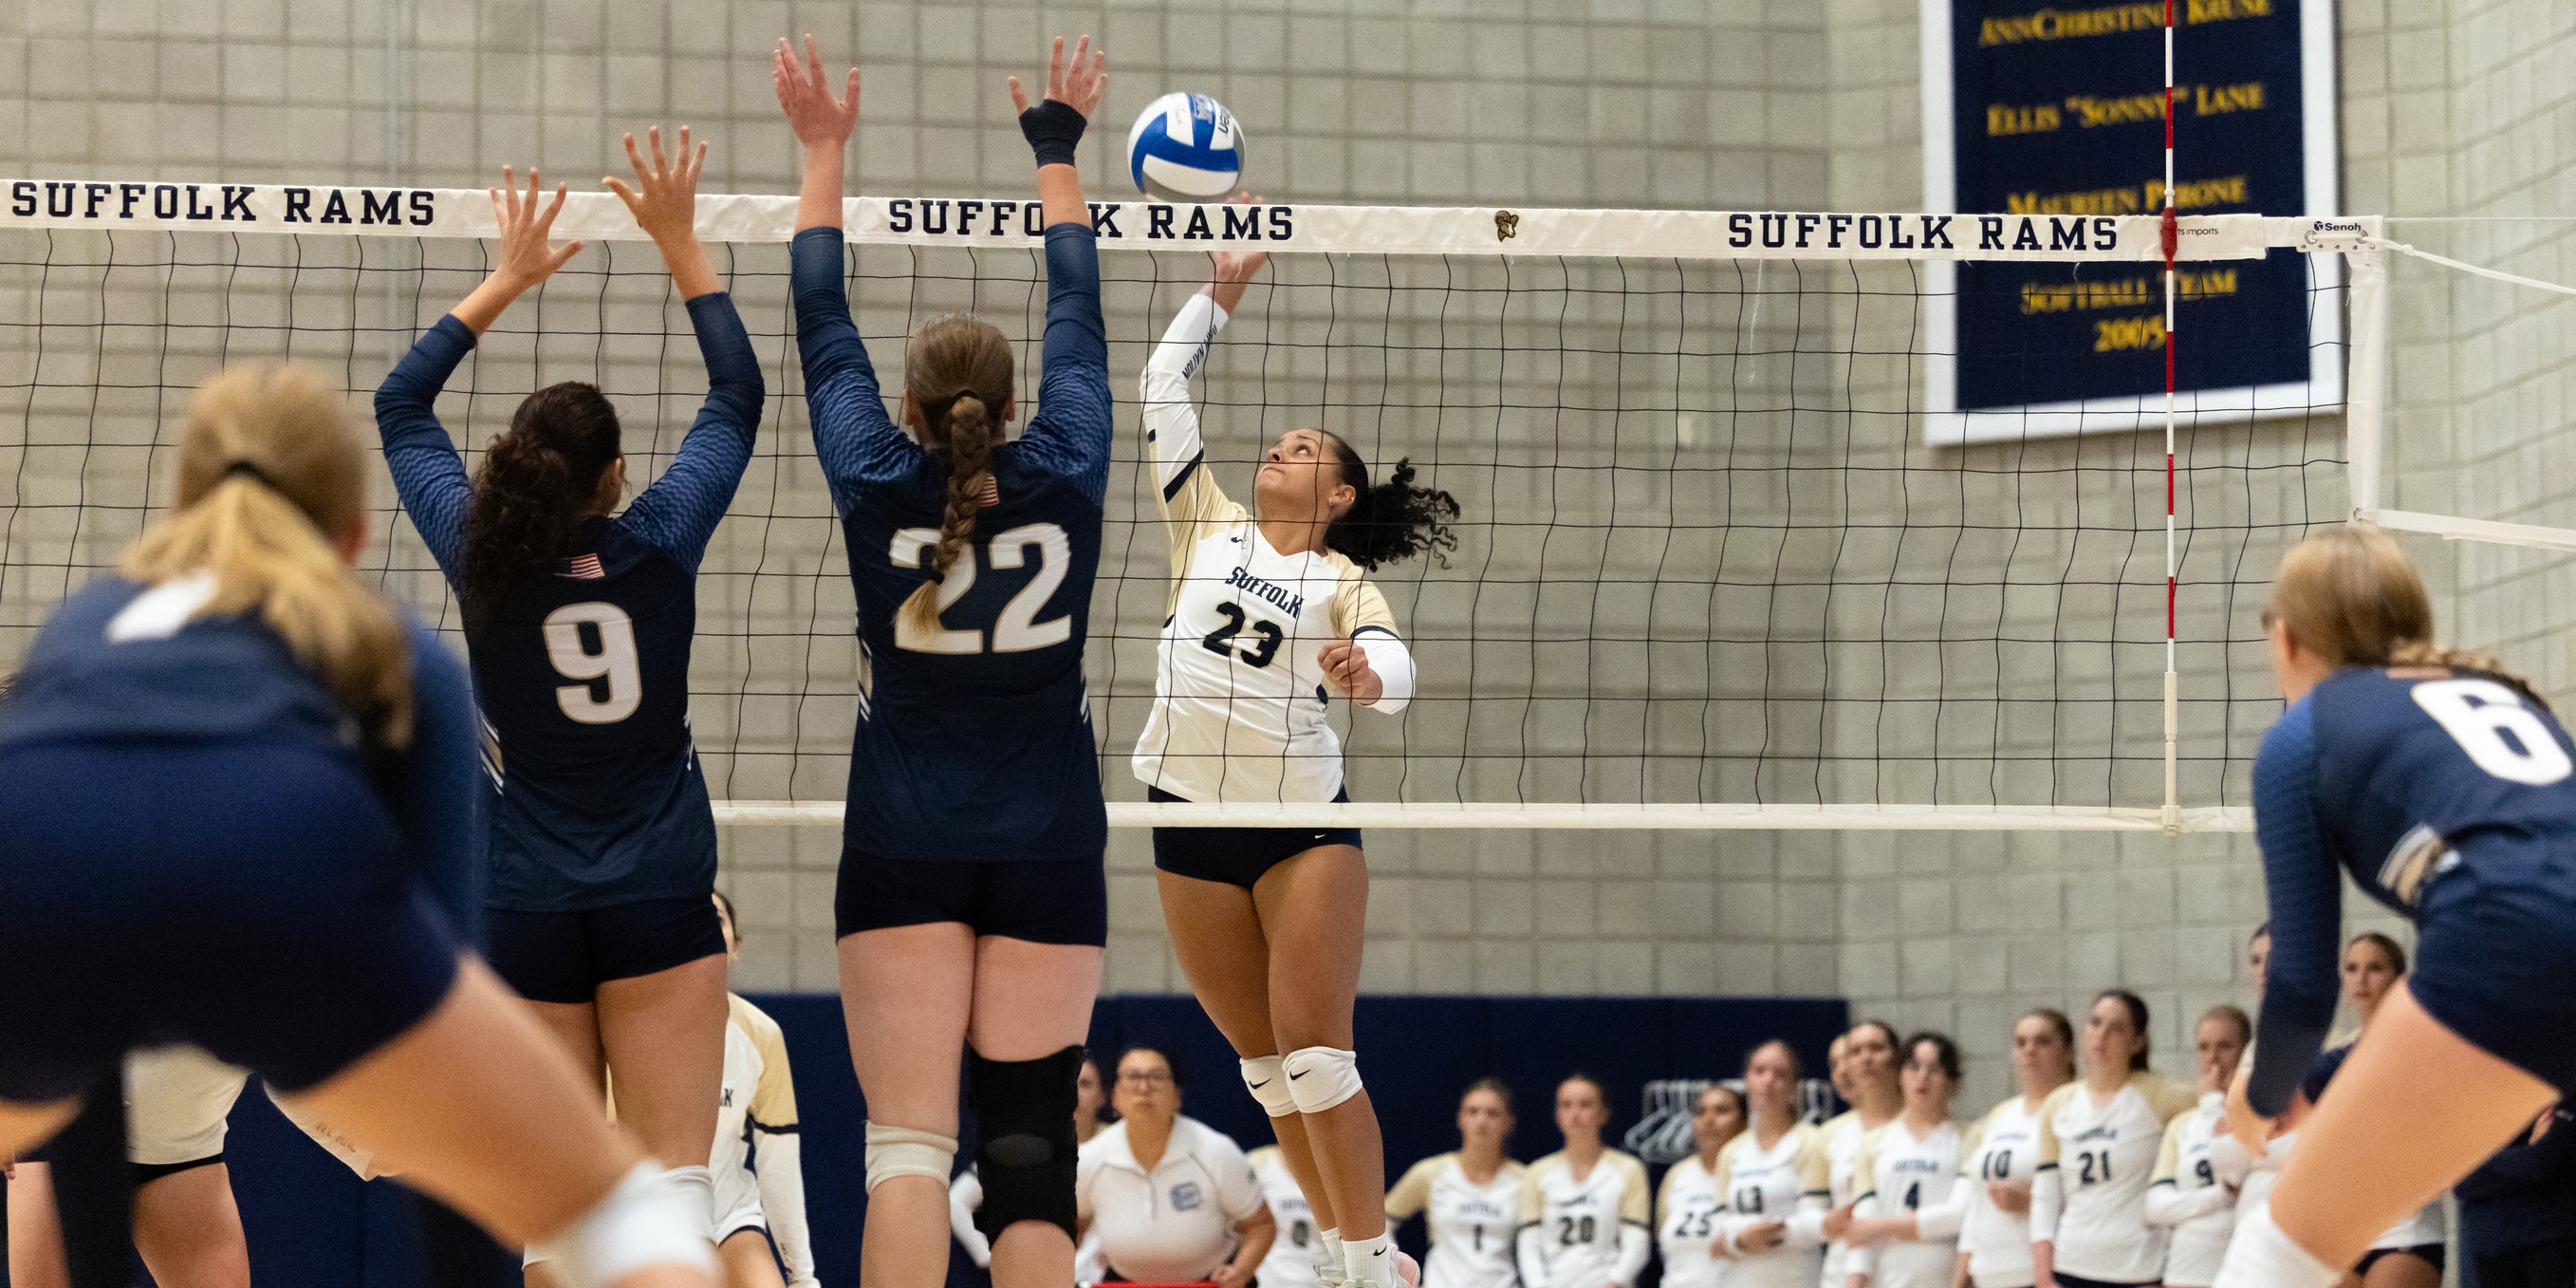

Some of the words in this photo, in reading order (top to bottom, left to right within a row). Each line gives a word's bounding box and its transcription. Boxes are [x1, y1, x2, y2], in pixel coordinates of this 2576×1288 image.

[12, 182, 256, 221] SUFFOLK
[284, 189, 434, 226] RAMS
[889, 199, 1122, 239] SUFFOK
[1147, 205, 1293, 241] RAMS
[1729, 214, 1954, 249] SUFFOLK
[1978, 217, 2118, 251] RAMS
[2325, 222, 2362, 232] Senoh
[888, 522, 1072, 655] 22
[1224, 566, 1306, 619] SUFFOLK
[1202, 601, 1284, 669] 23
[541, 601, 643, 725] 9
[2411, 679, 2573, 786] 6
[2078, 1148, 2111, 1185] 21
[1559, 1215, 1596, 1246] 20
